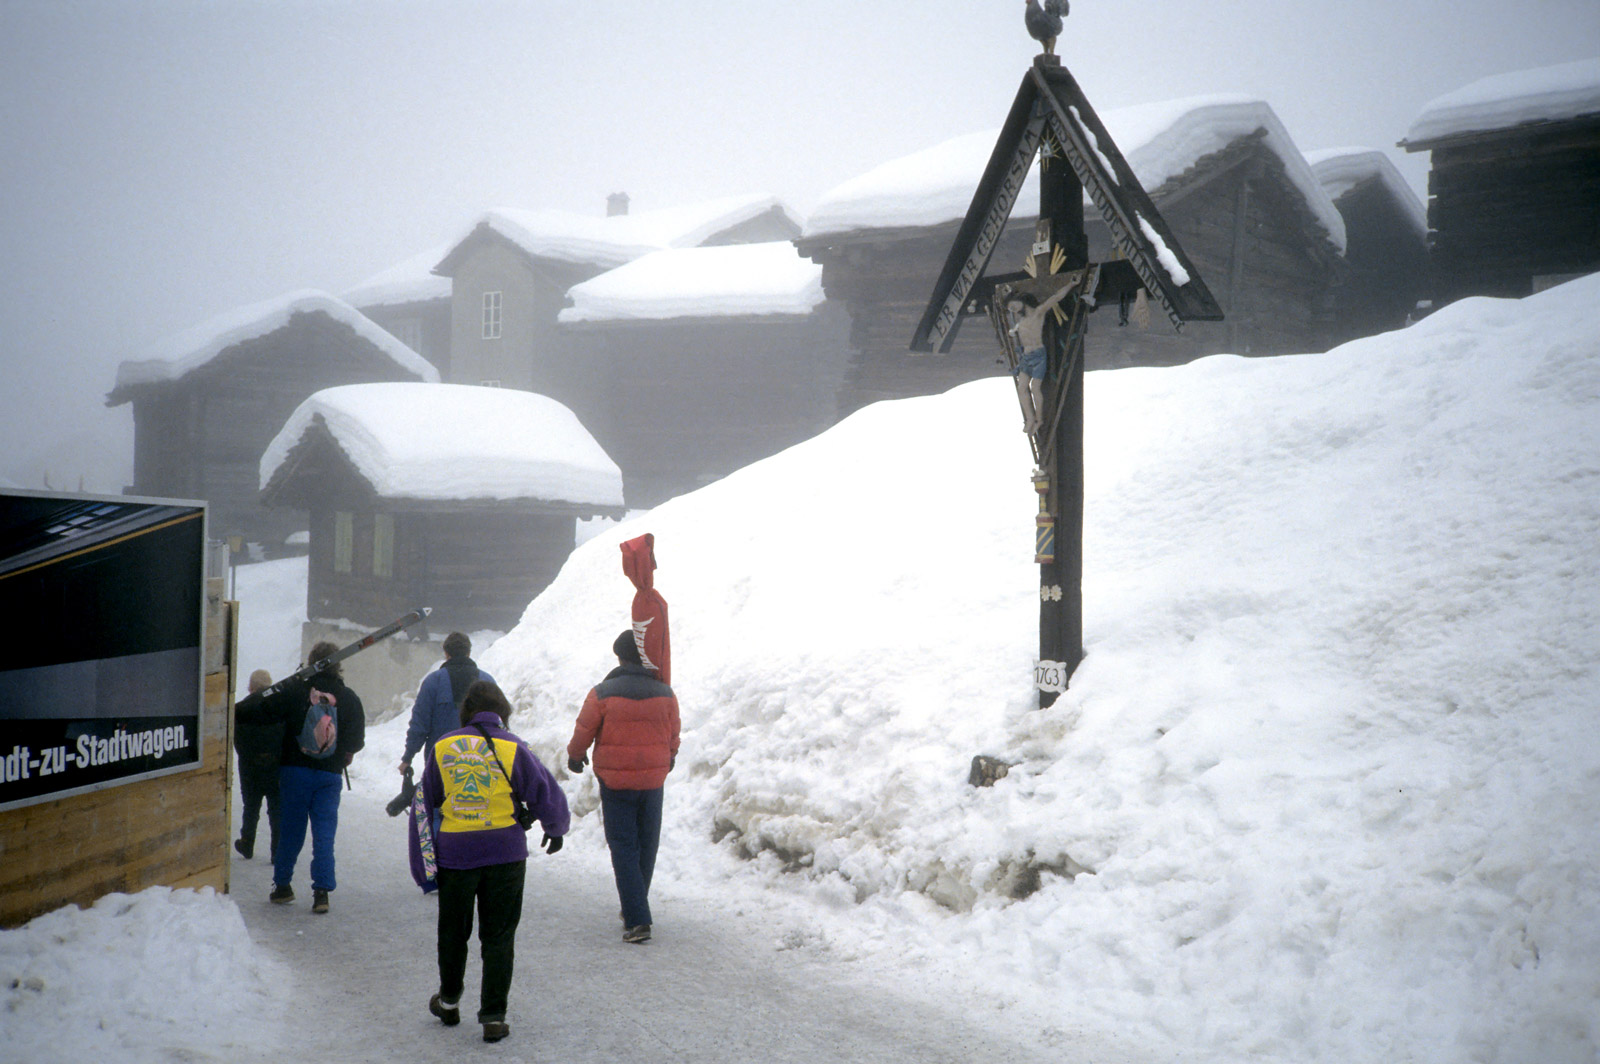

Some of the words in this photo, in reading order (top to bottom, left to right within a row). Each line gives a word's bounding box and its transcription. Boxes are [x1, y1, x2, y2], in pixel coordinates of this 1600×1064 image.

[934, 304, 955, 338] ER
[950, 258, 978, 301] WAR
[977, 128, 1038, 257] GEHORSAM
[1034, 666, 1060, 687] 1763
